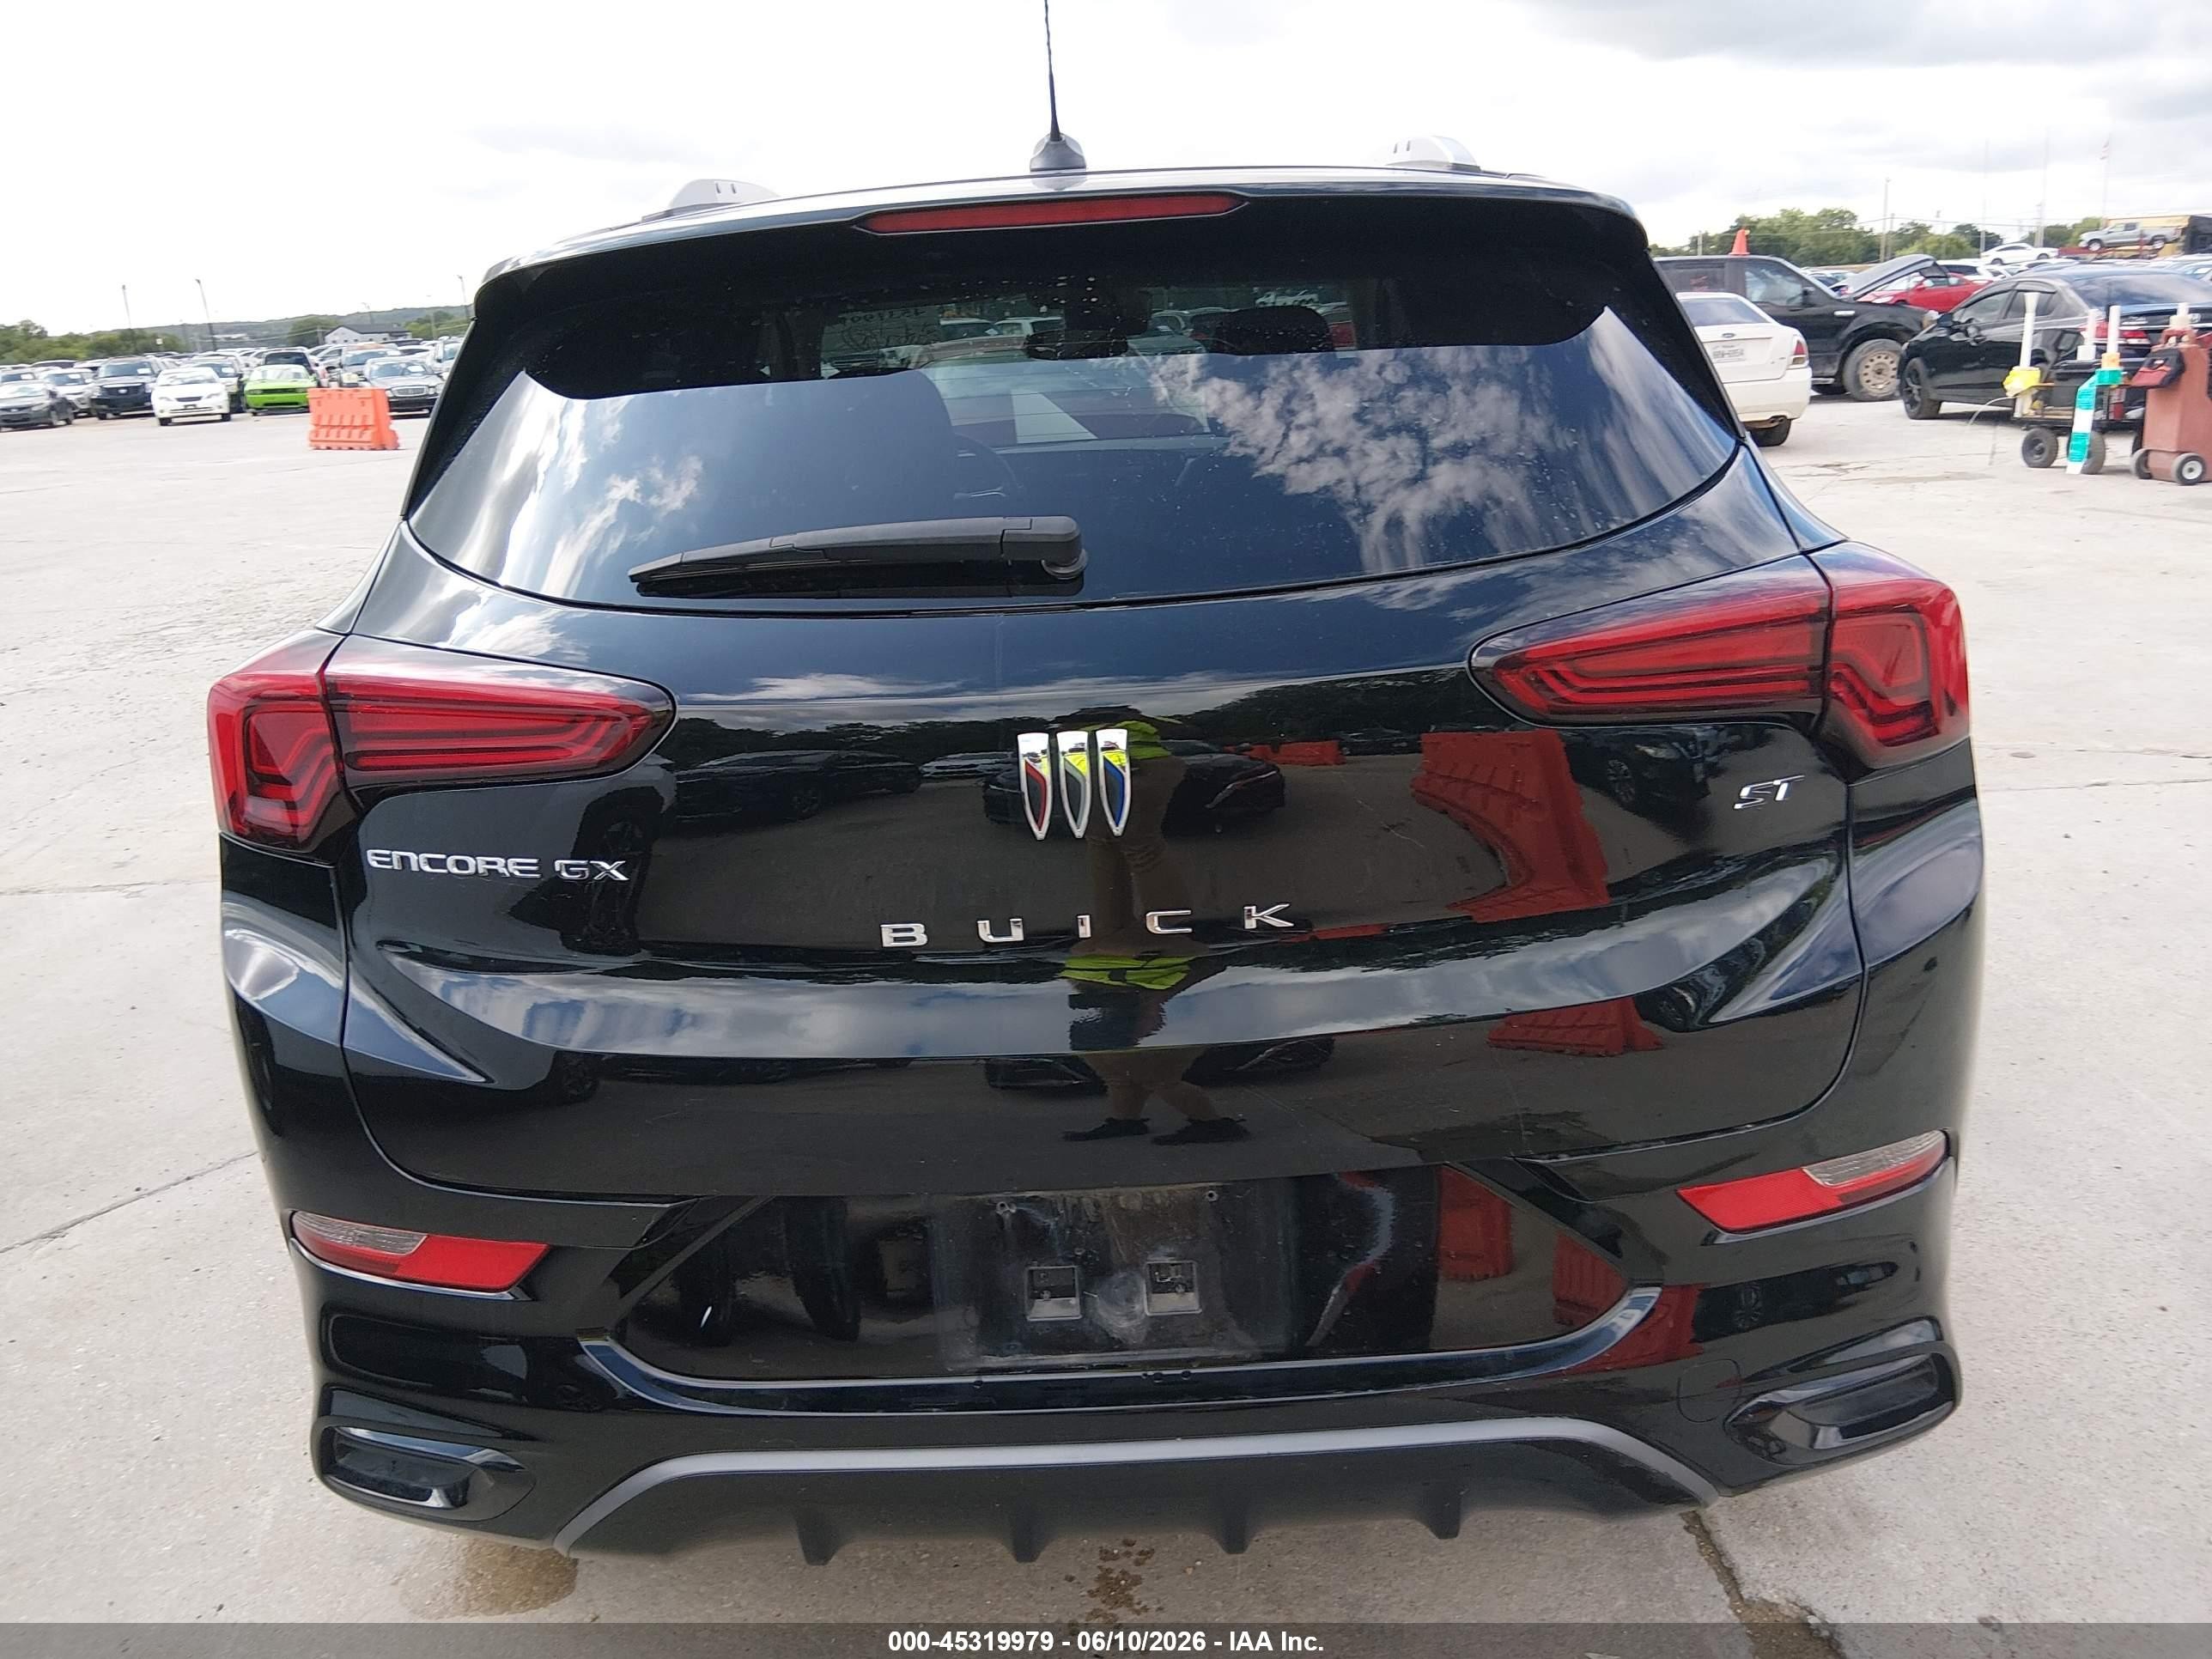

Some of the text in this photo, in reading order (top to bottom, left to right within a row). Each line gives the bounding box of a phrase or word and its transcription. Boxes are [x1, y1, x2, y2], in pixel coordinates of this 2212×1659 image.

[1734, 775, 1805, 810] ST
[366, 848, 630, 881] ENCORE GX
[880, 903, 1294, 947] BUICK
